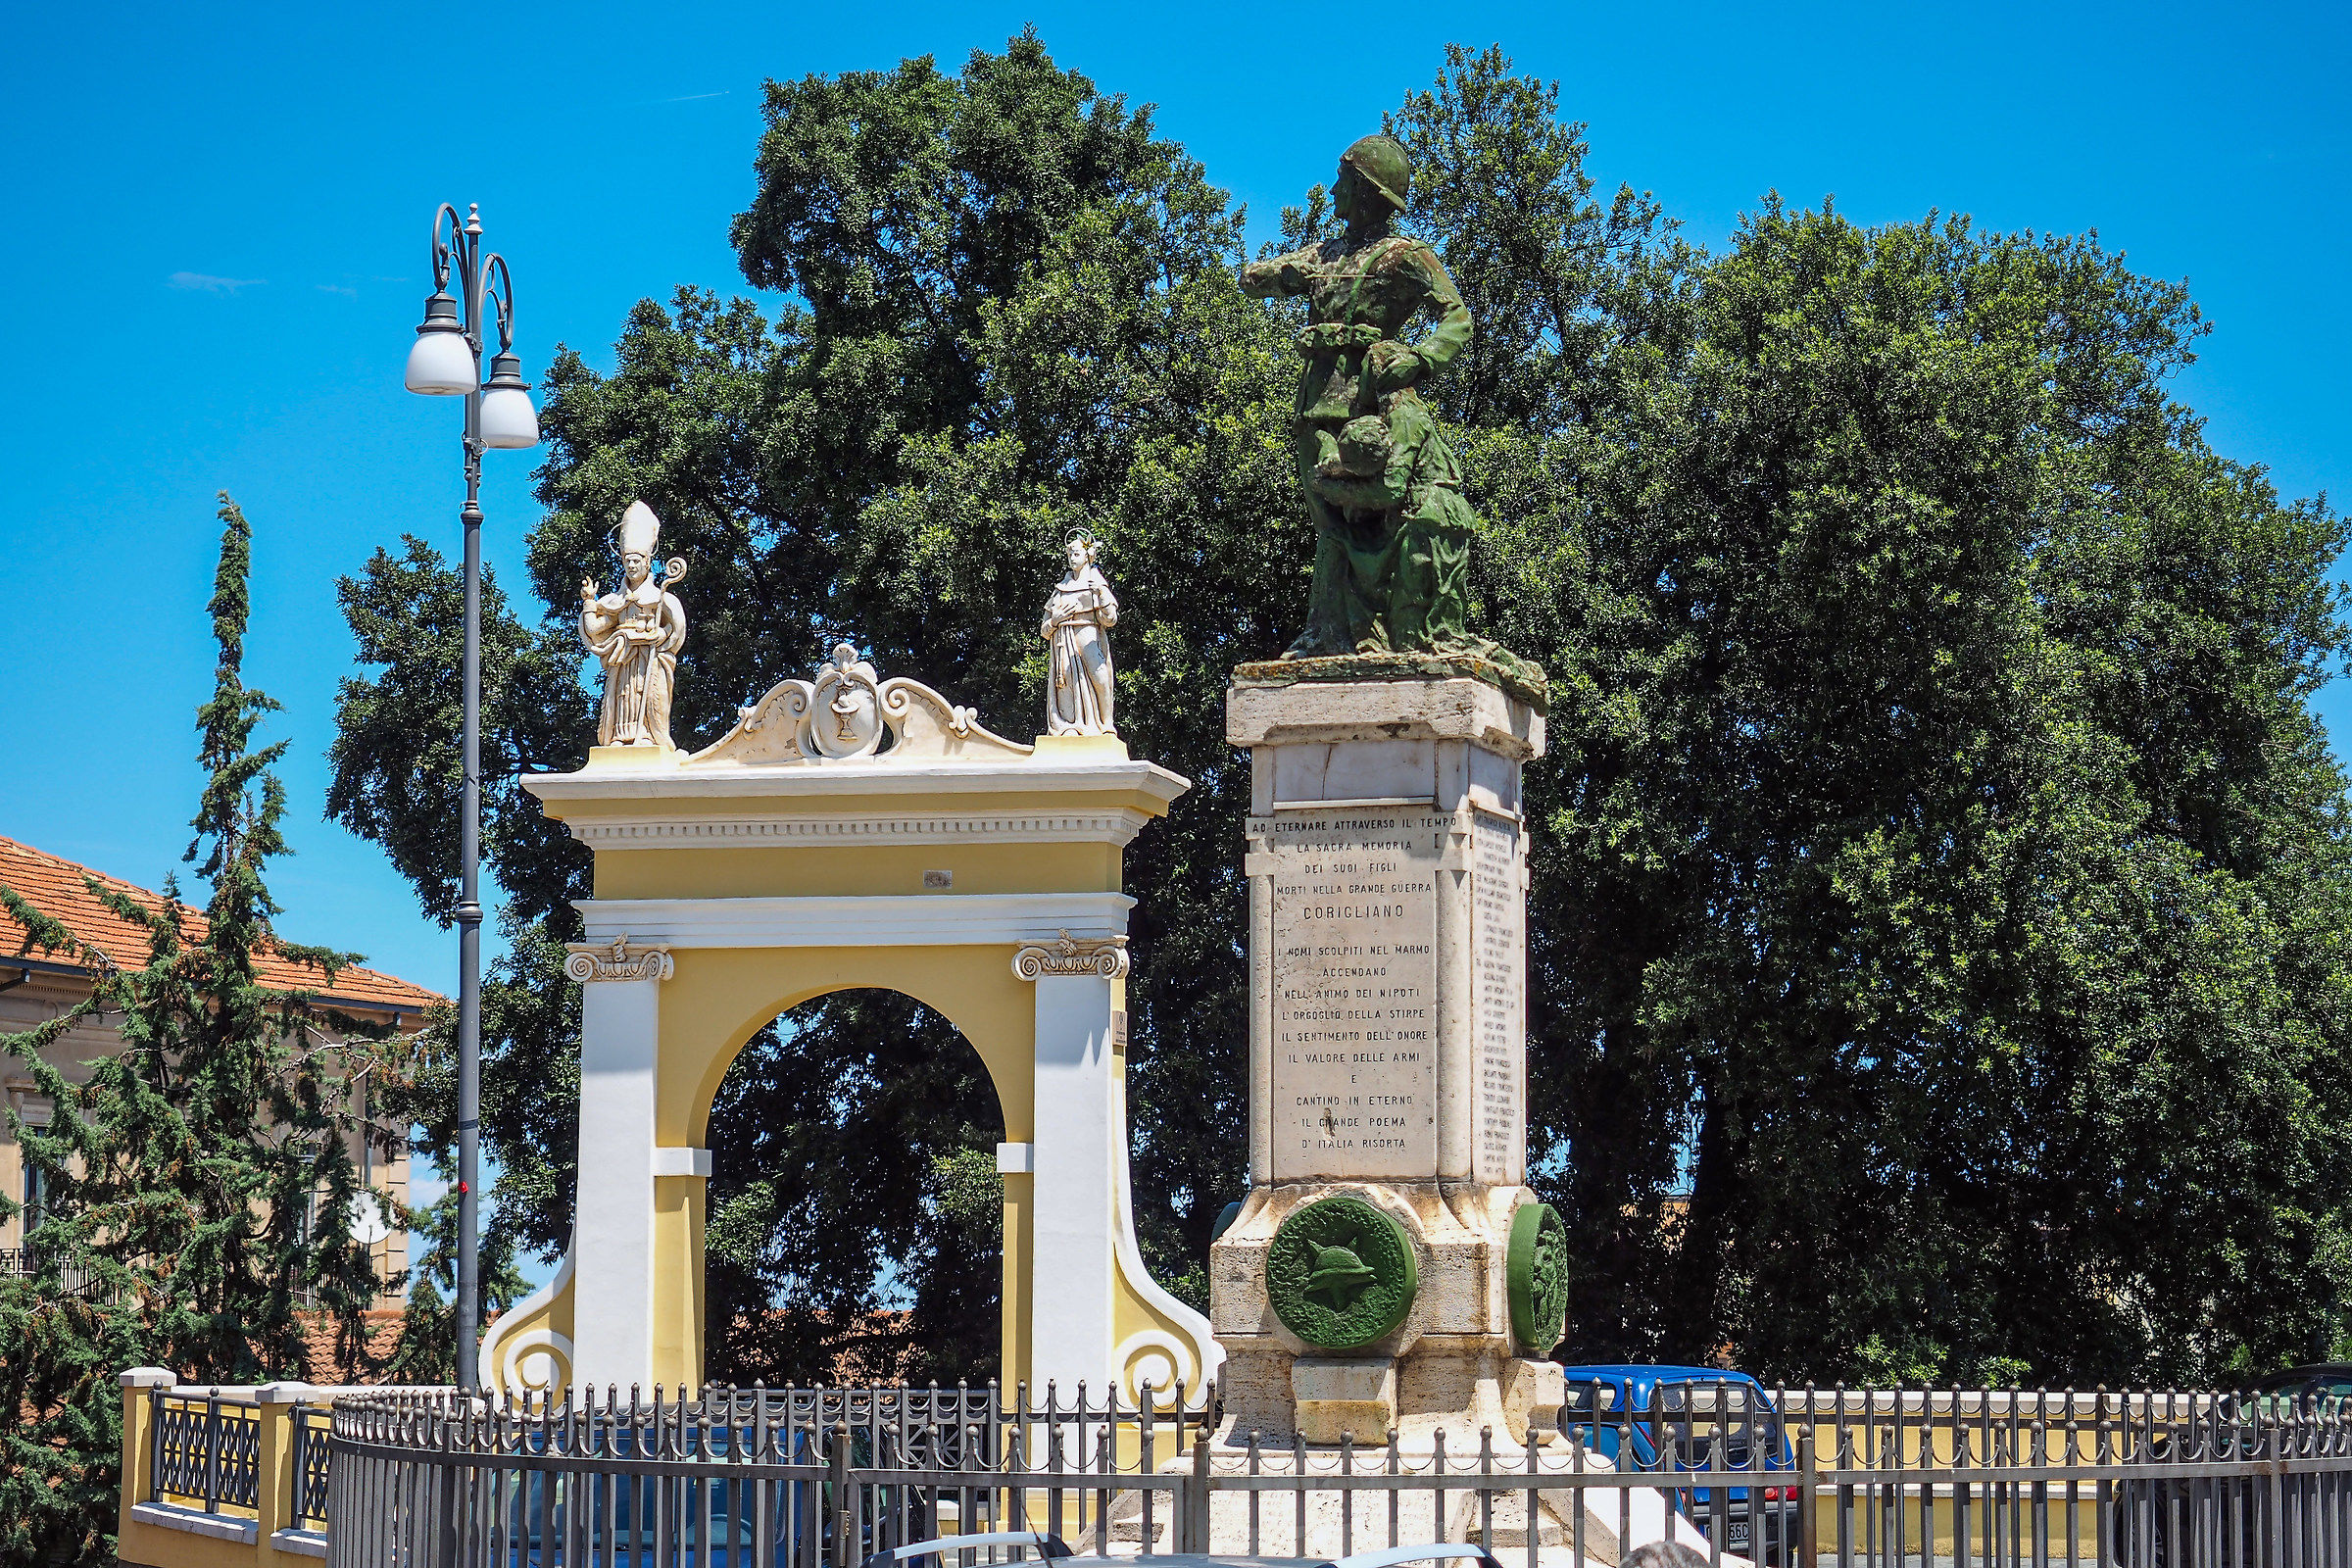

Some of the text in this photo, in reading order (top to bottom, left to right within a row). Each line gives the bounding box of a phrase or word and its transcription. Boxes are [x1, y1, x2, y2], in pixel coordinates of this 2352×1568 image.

[1252, 817, 1456, 832] AD ETERNARE ATTRAVERSO IL TEMPO
[1297, 841, 1412, 854] LA SACRA MEMORIA
[1304, 862, 1397, 874] DEI SUOI FIGLI
[1277, 883, 1432, 896] MORTI NELLA GRANDE GUERRA
[1303, 905, 1404, 920] CORIGLIANO
[1288, 947, 1312, 956] NOMI
[1318, 946, 1363, 956] SCOLPITI
[1370, 946, 1389, 956] NEL
[1395, 945, 1430, 955] MARMO
[1322, 967, 1387, 977] ACCENDANO
[1356, 989, 1373, 999] DEI
[1380, 988, 1420, 998] NIPOTI
[1348, 1009, 1382, 1019] DELLA
[1389, 1008, 1426, 1019] STIRPE
[1282, 1032, 1292, 1043] IL
[1297, 1031, 1360, 1042] SENTIMENTO
[1288, 1053, 1421, 1063] IL VALORE DELLE ARMI
[1350, 1074, 1358, 1084] E
[1296, 1096, 1413, 1106] CANTINO IN ETERNO
[1301, 1118, 1311, 1128] IL
[1369, 1117, 1406, 1127] POEMA
[1362, 1138, 1406, 1149] RISORTA
